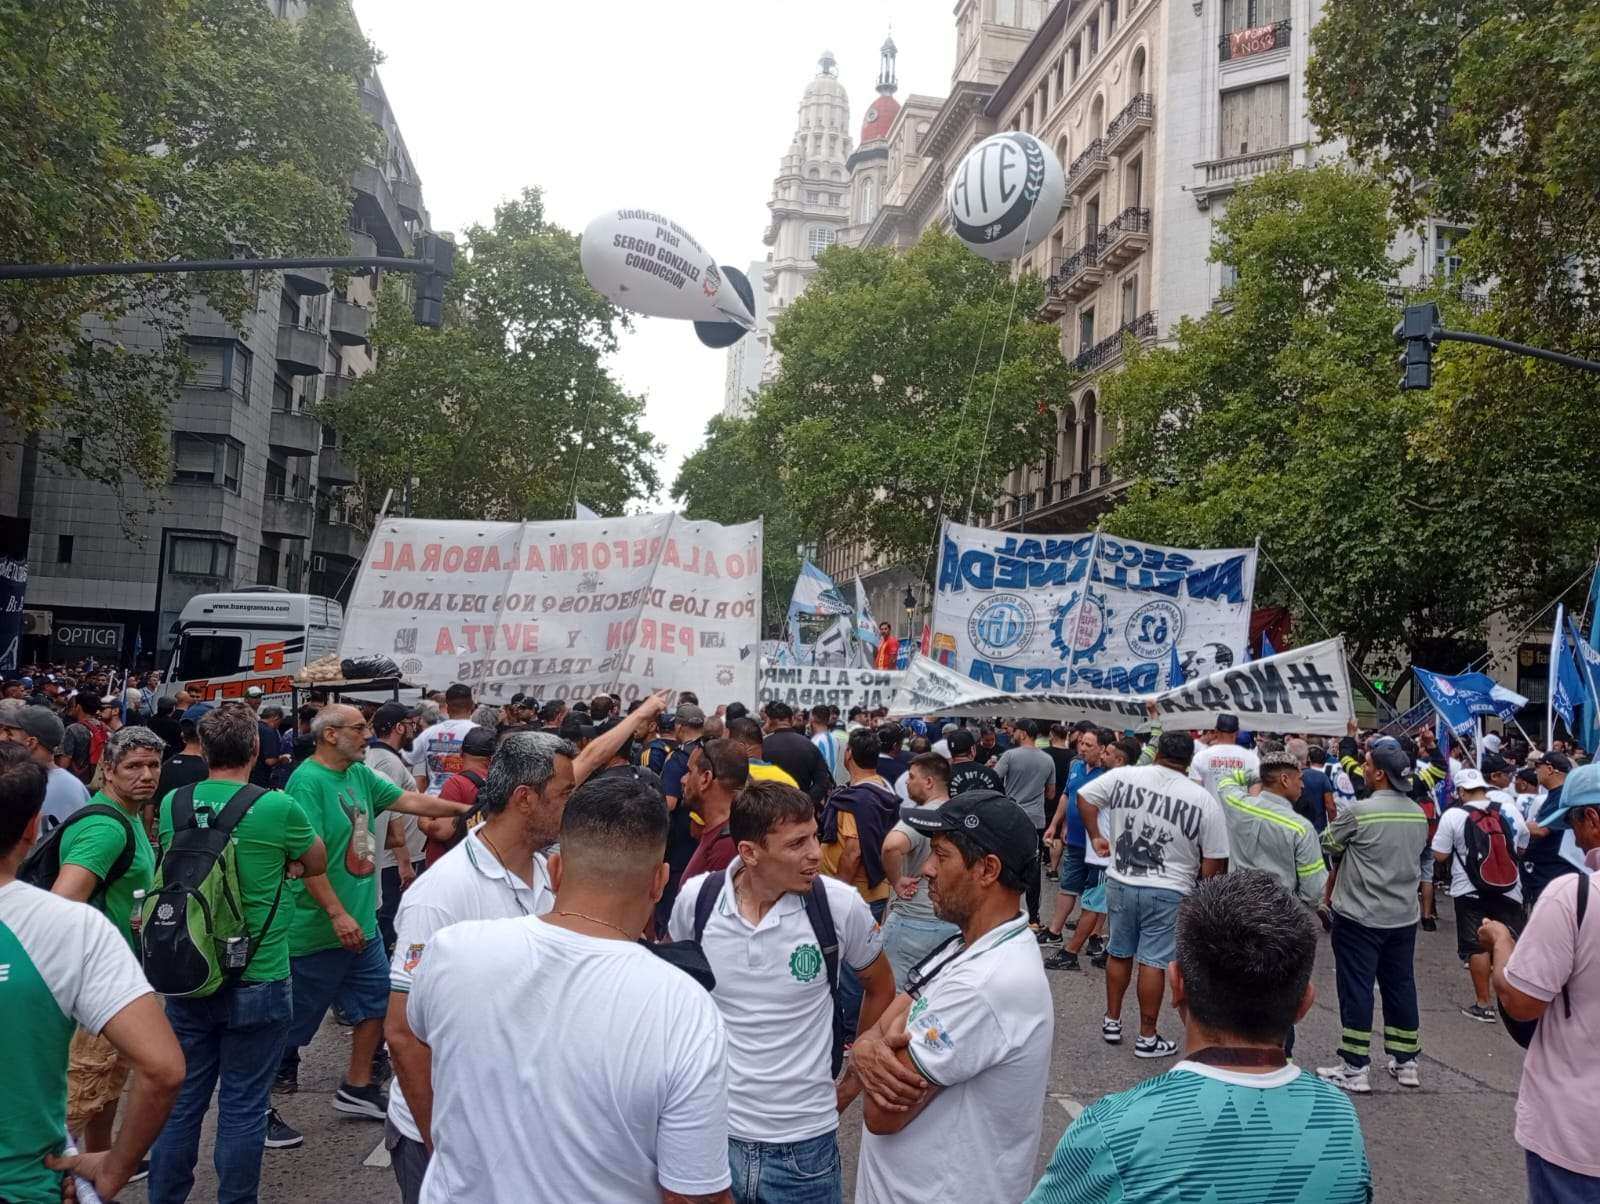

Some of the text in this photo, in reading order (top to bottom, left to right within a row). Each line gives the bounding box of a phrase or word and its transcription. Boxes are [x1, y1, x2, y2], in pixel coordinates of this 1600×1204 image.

[617, 208, 668, 226] Sindicato
[656, 226, 680, 248] Pilar
[613, 233, 656, 257] SERGIO
[657, 247, 701, 282] GONZALEZ
[1110, 779, 1203, 842] BASTARD
